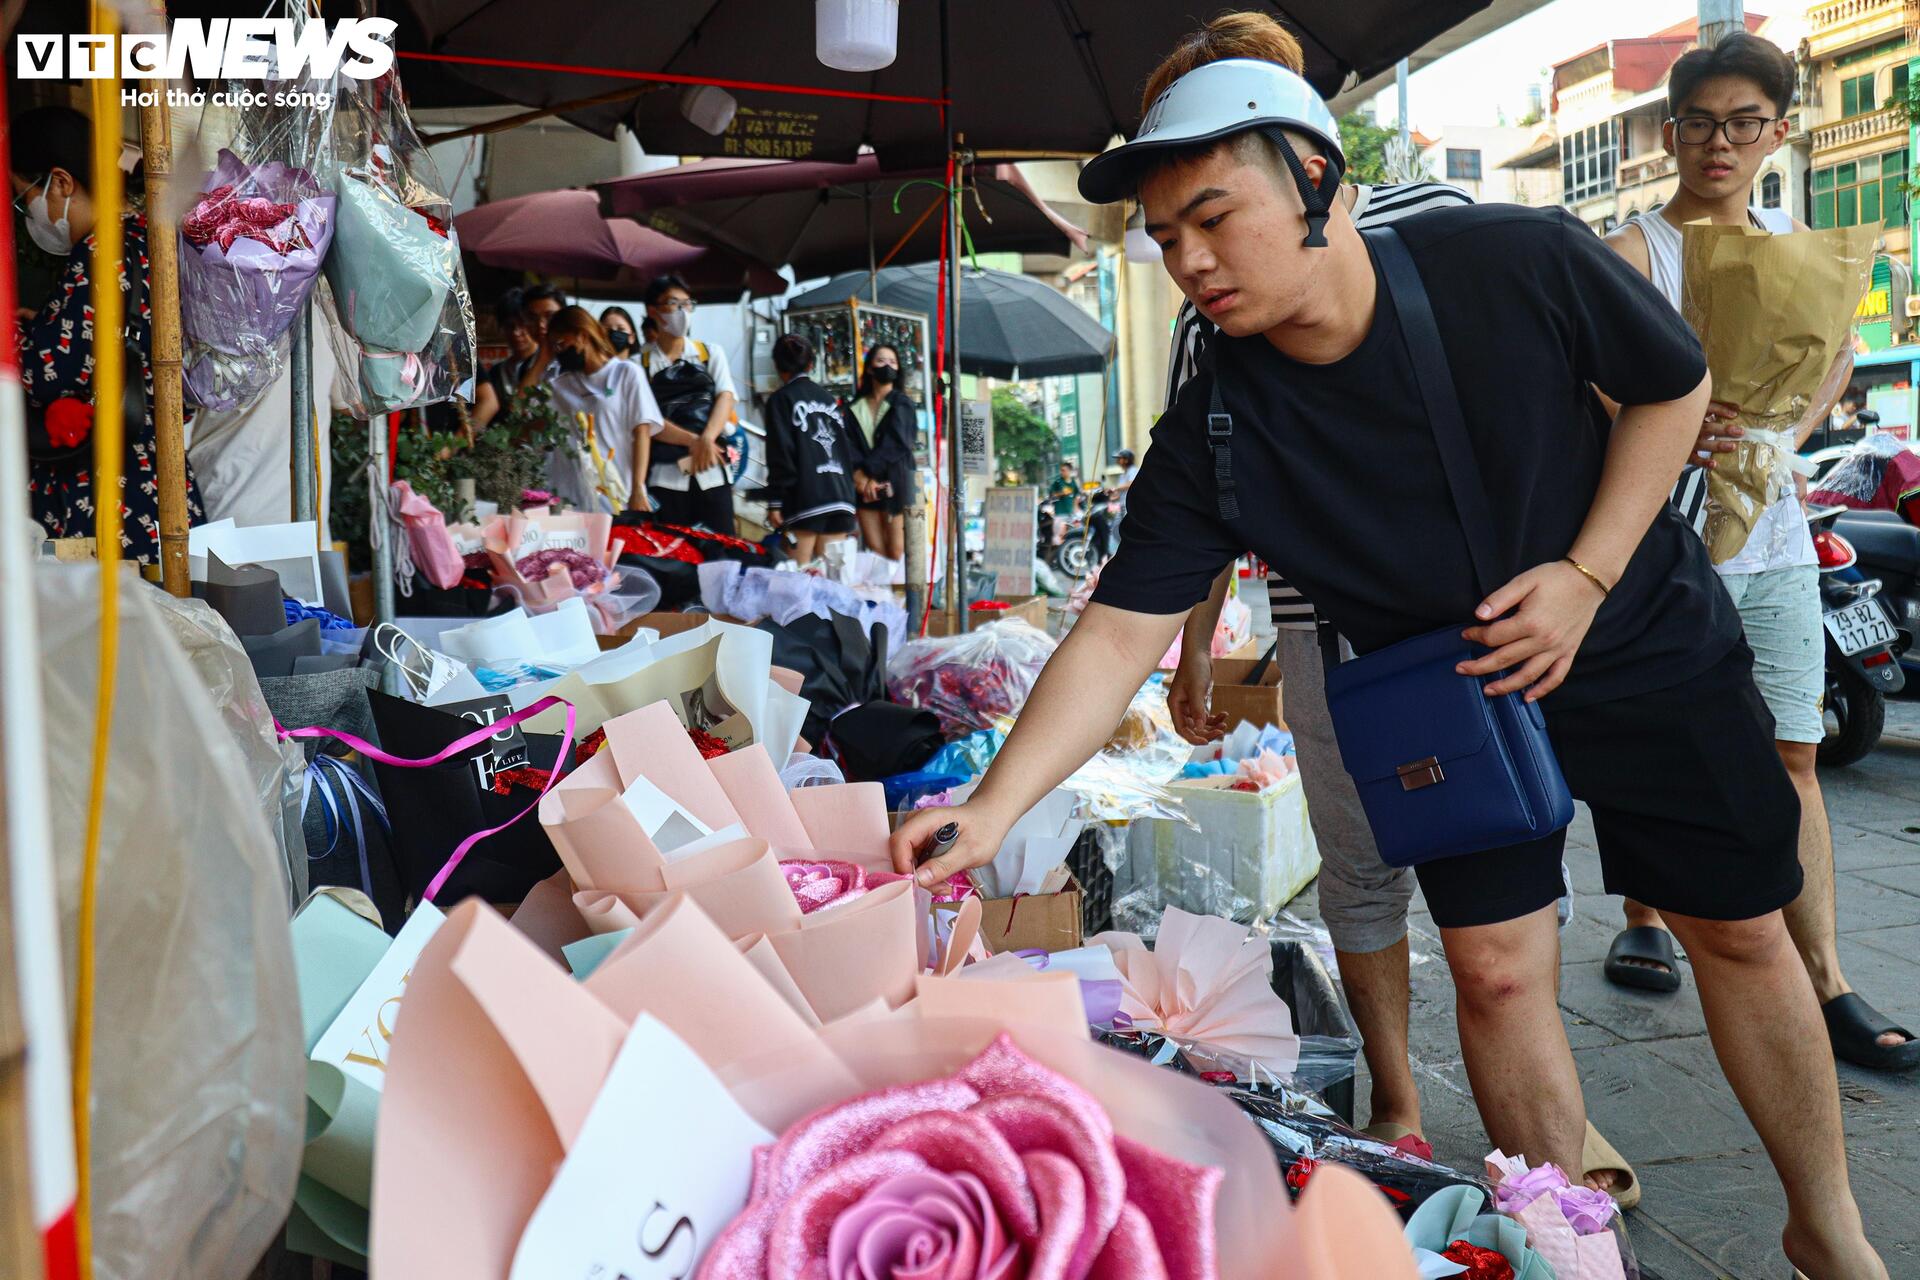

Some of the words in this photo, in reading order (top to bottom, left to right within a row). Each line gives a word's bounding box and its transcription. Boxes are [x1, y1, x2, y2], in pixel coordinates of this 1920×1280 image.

[1832, 604, 1876, 631] 29-B2
[1840, 621, 1889, 652] 217.27
[502, 754, 523, 765] LIFE
